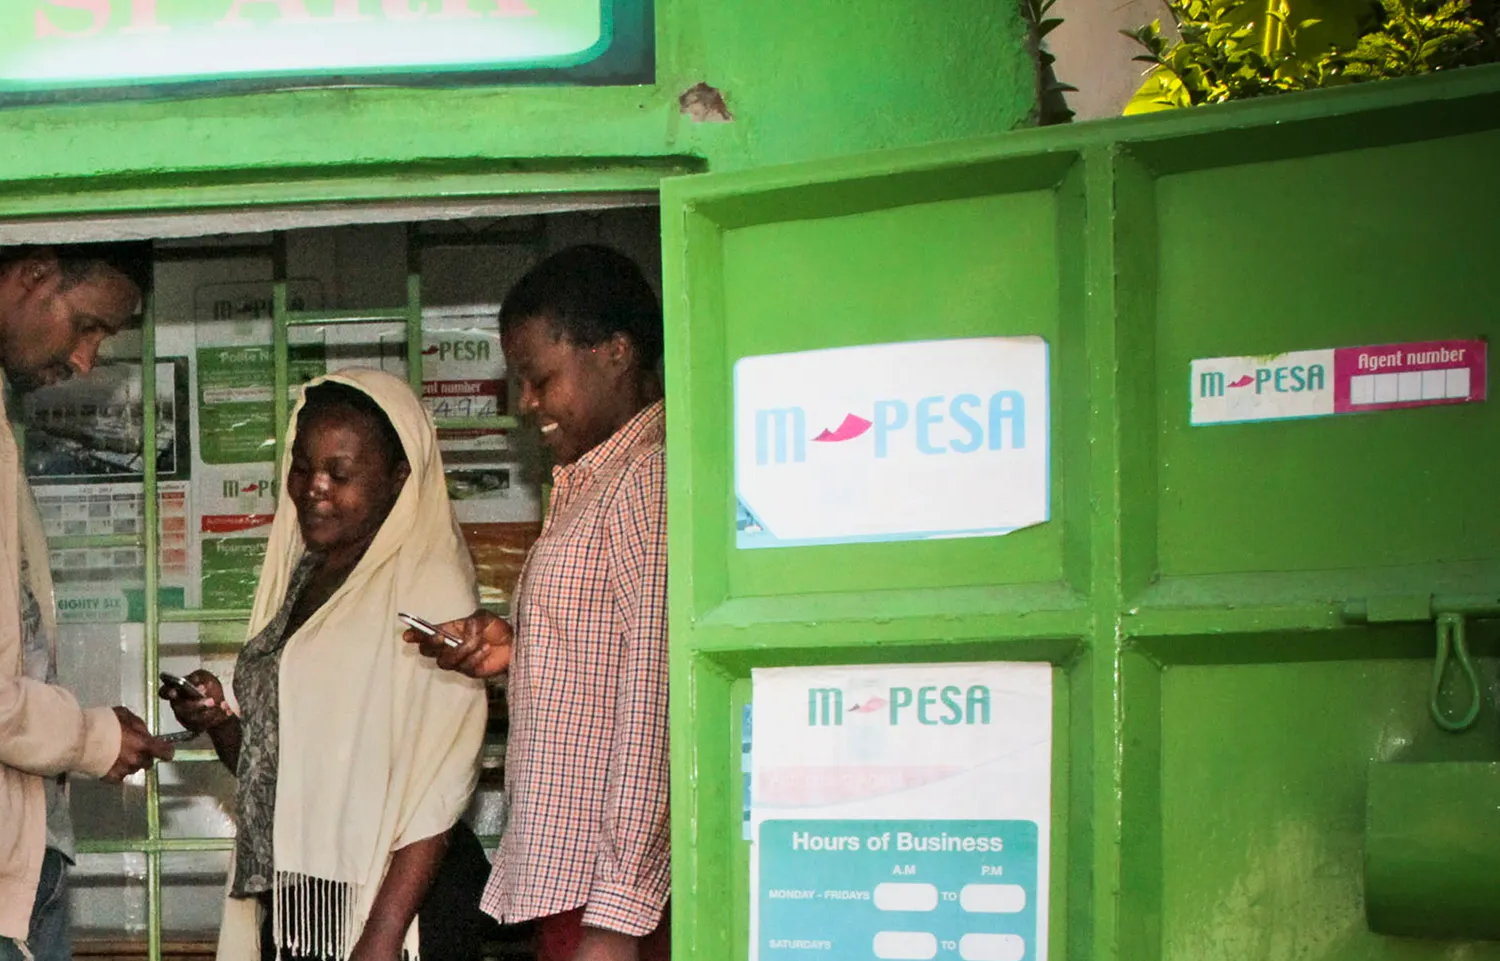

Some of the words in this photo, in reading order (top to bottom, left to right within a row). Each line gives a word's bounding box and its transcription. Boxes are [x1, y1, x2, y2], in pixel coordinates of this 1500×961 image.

[1358, 352, 1403, 371] Agent
[1407, 347, 1466, 364] number
[441, 381, 482, 394] number
[1255, 363, 1325, 395] PESA
[873, 388, 1027, 459] PESA
[889, 684, 991, 726] PESA
[792, 831, 860, 852] Hours
[866, 831, 891, 851] of
[896, 831, 1003, 852] Business
[768, 889, 816, 900] MONDAY
[824, 889, 871, 901] FRIDAYS
[941, 891, 958, 902] TO
[768, 938, 832, 951] SATURDAYS
[941, 940, 957, 951] TO
